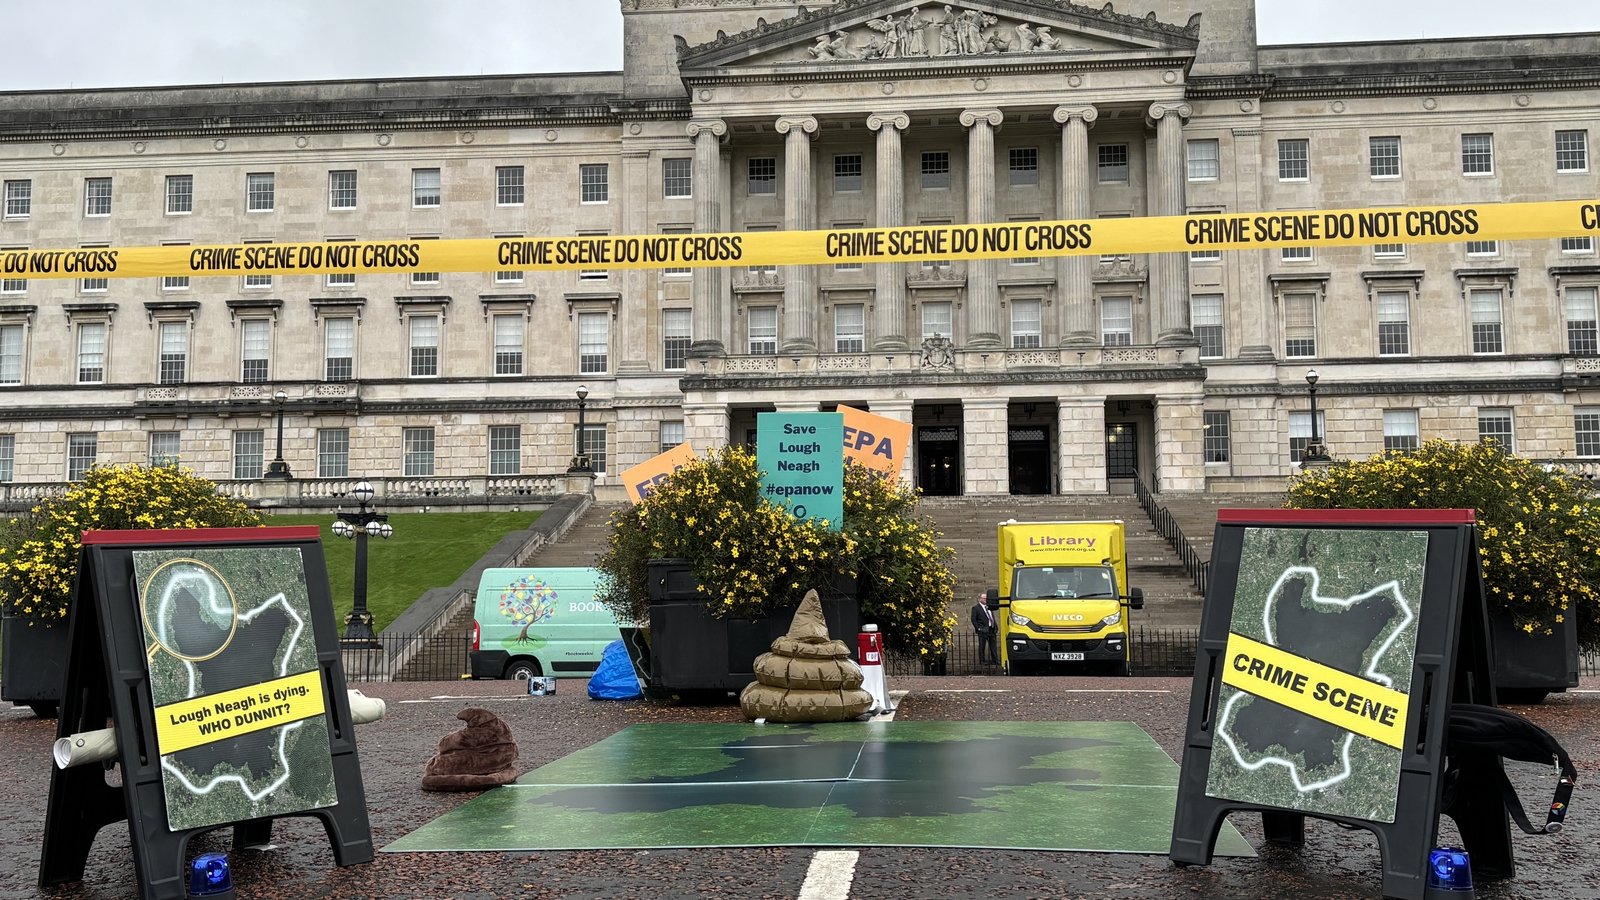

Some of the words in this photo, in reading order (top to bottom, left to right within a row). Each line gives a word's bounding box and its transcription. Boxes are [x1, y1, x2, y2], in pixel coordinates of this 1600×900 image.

[1185, 218, 1250, 244] CRIME
[1254, 215, 1320, 242] SCENE
[1324, 213, 1355, 239] DO
[1359, 211, 1402, 238] NOT
[1405, 209, 1479, 236] CROSS
[498, 241, 553, 265] CRIME
[555, 239, 612, 264] SCENE
[614, 239, 639, 262] DO
[643, 238, 680, 261] NOT
[682, 236, 742, 260] CROSS
[826, 231, 885, 257] CRIME
[888, 229, 948, 255] SCENE
[951, 228, 979, 253] DO
[982, 226, 1023, 252] NOT
[1025, 223, 1092, 250] CROSS
[4, 253, 28, 272] DO
[30, 252, 64, 272] NOT
[64, 251, 118, 272] CROSS
[190, 248, 243, 270] CRIME
[244, 247, 297, 269] SCENE
[300, 246, 322, 268] DO
[326, 245, 361, 267] NOT
[362, 244, 419, 267] CROSS
[783, 423, 817, 435] Save
[779, 442, 821, 455] Lough
[777, 460, 820, 473] Neagh
[766, 483, 834, 498] #epanow
[1029, 536, 1097, 548] Library
[1233, 653, 1309, 695] CRIME
[1312, 682, 1399, 728] SCENE
[170, 707, 212, 726] Lough
[214, 696, 256, 715] Neagh
[259, 693, 271, 704] is
[273, 685, 310, 705] dying.
[198, 718, 232, 736] WHO
[234, 703, 291, 727] DUNNIT?
